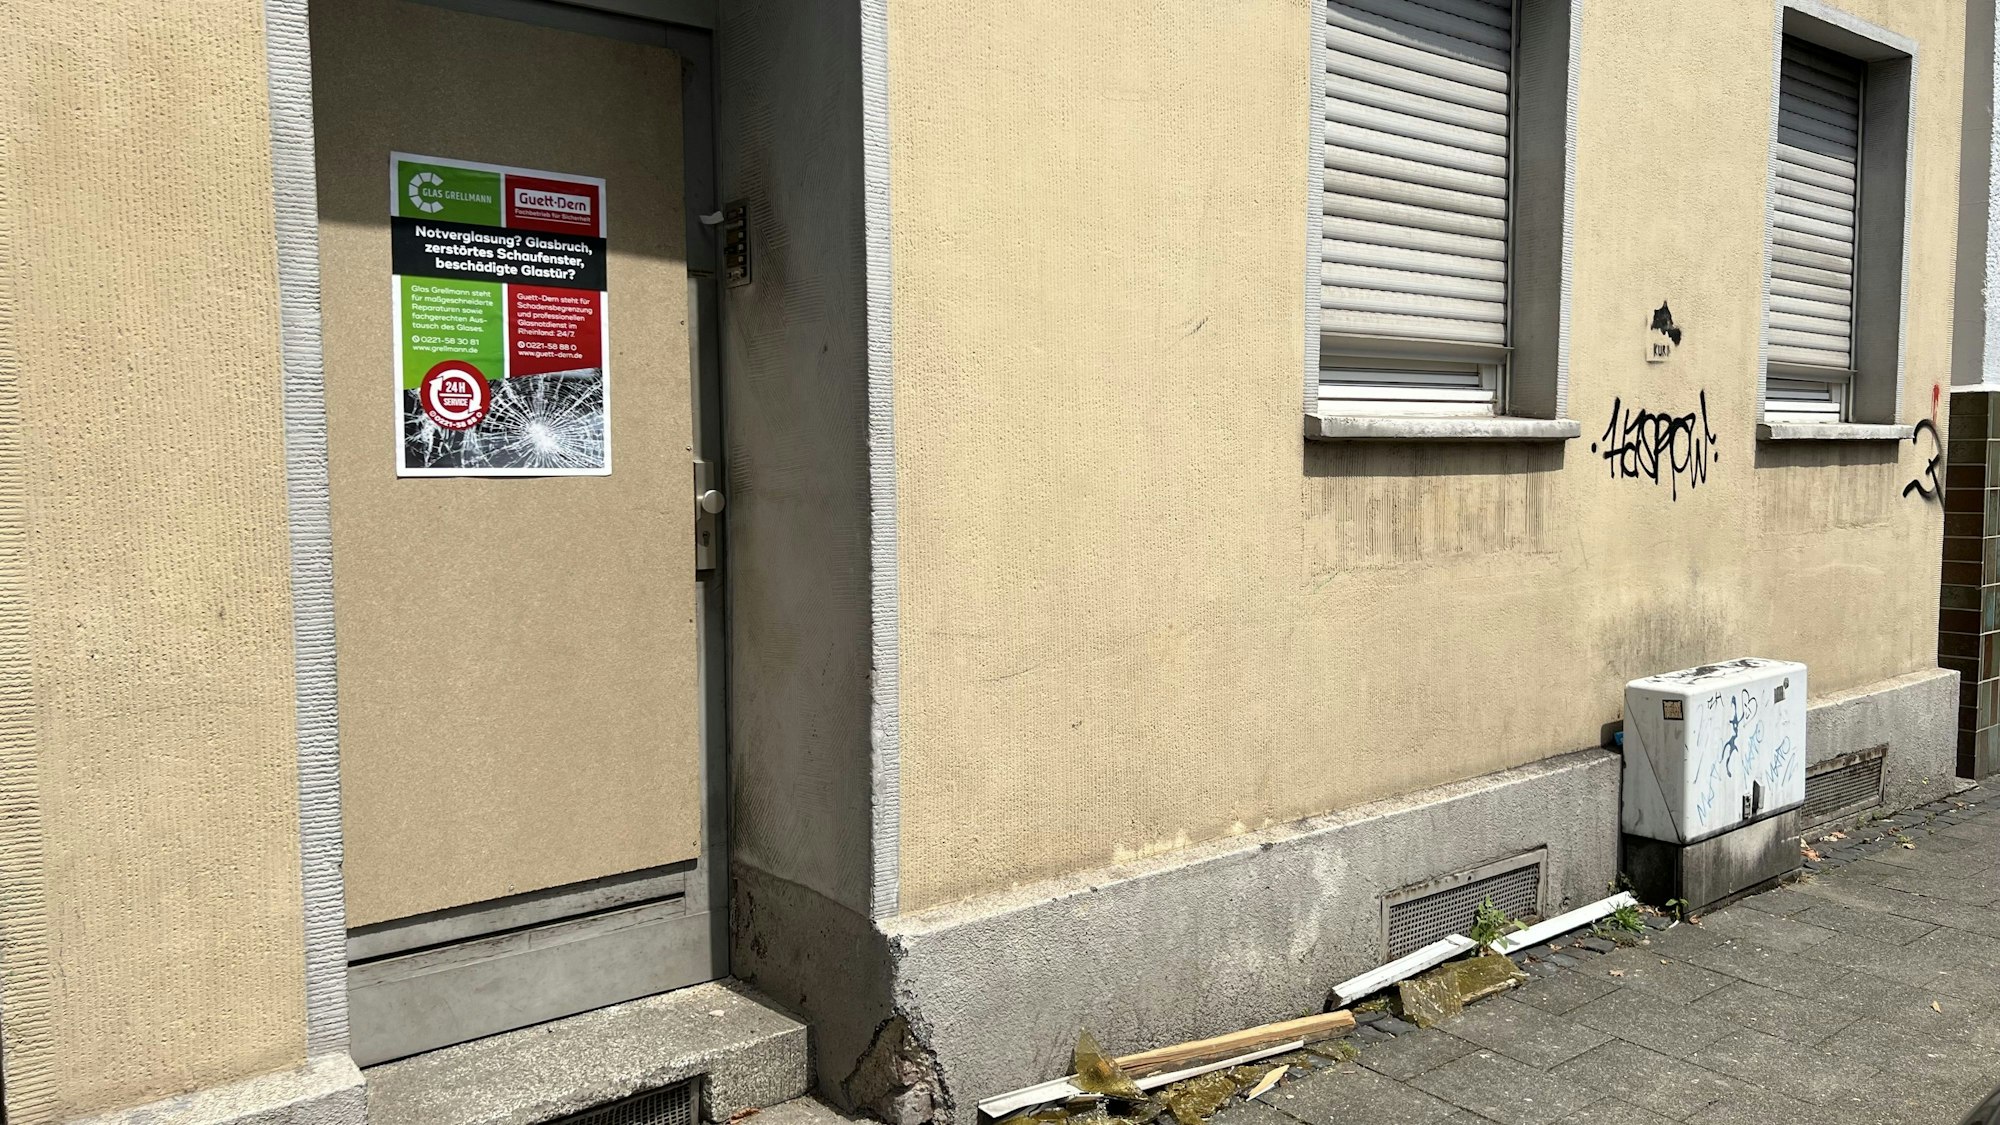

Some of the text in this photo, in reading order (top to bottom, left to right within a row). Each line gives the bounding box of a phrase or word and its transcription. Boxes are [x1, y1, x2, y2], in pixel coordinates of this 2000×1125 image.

[422, 187, 492, 204] GLAS GRELLMANN
[514, 208, 551, 218] Fachbetrieb
[561, 213, 591, 223] Sicherheit
[415, 225, 593, 256] Notverglasung? Glasbruch,
[424, 243, 585, 269] zerstörtes Schaufenster,
[435, 256, 576, 280] beschädigte Glastür?
[411, 285, 492, 298] Glas Grellmann steht
[411, 294, 494, 307] für maßgeschneiderte
[516, 292, 560, 303] Guett-Dern
[560, 297, 579, 305] steht
[411, 303, 461, 313] Reparaturen
[516, 301, 593, 316] Schadensbegrenzung
[411, 312, 488, 324] fachgerechten Aus-
[517, 311, 586, 322] und professionellen
[412, 322, 485, 333] tausch des Glases.
[517, 319, 578, 330] Glasnotdienst im
[420, 336, 456, 344] 0221-58
[469, 338, 480, 346] 81
[525, 341, 558, 349] 0221-58
[558, 343, 570, 351] 88
[412, 345, 479, 354] www.grellmann.de
[517, 350, 583, 360] www.guett-dern.de
[445, 381, 466, 393] 24 H
[443, 398, 469, 407] SERVICE
